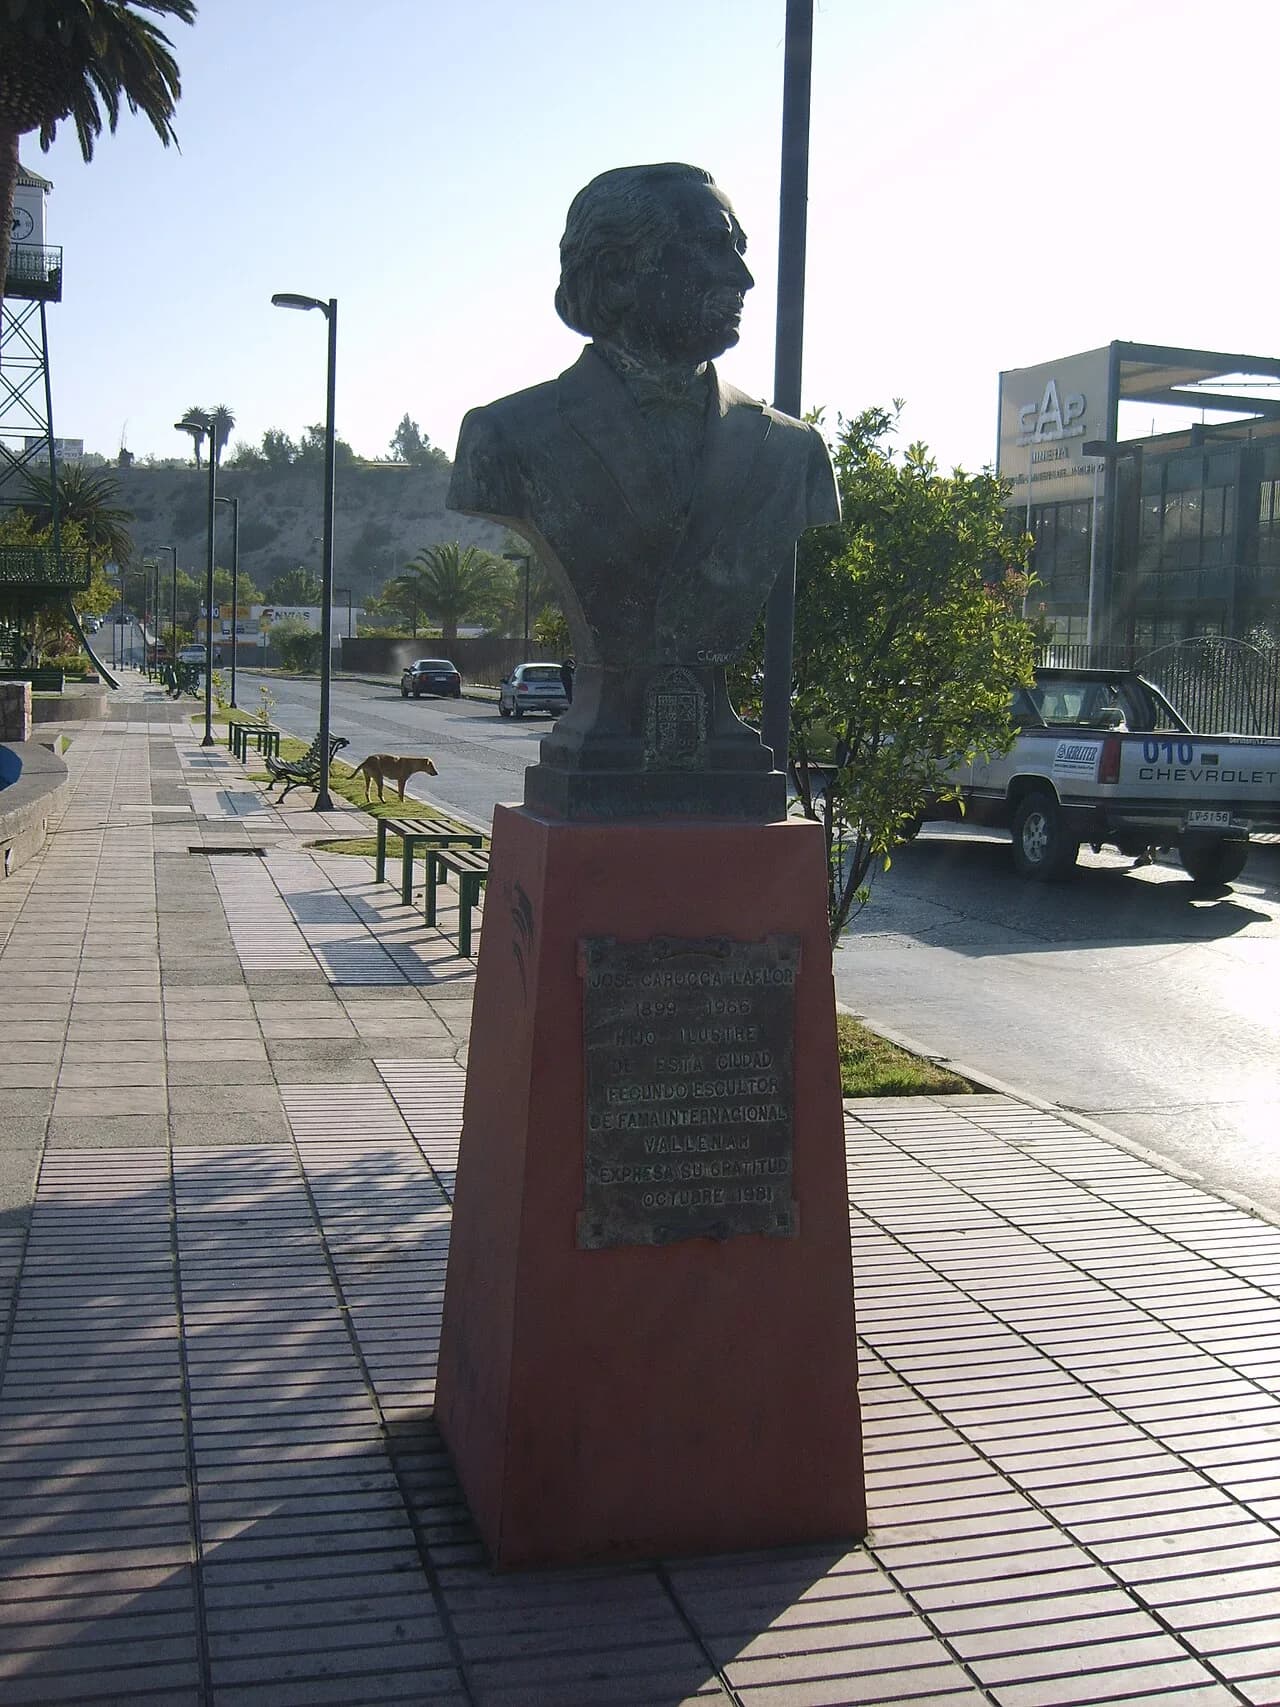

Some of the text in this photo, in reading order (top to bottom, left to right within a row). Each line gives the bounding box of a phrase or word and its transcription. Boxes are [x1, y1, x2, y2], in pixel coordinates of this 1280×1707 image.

[1018, 377, 1087, 442] CAP
[1143, 740, 1194, 765] 010
[1138, 767, 1278, 784] CHEVROLET
[635, 998, 751, 1017] 1899 1966
[615, 1024, 758, 1046] HIJO ILUSTRE
[656, 1056, 703, 1072] ESTA
[717, 1051, 773, 1070] CIUDAD
[607, 1078, 779, 1103] FECUNDO ESCULTOR
[617, 1110, 660, 1129] FAMA
[662, 1104, 787, 1127] INTERNACIONAL
[644, 1135, 750, 1153] VALLENAR
[599, 1157, 788, 1184] EXPRESA SU GRATITUD
[641, 1186, 724, 1207] OCTUBRE
